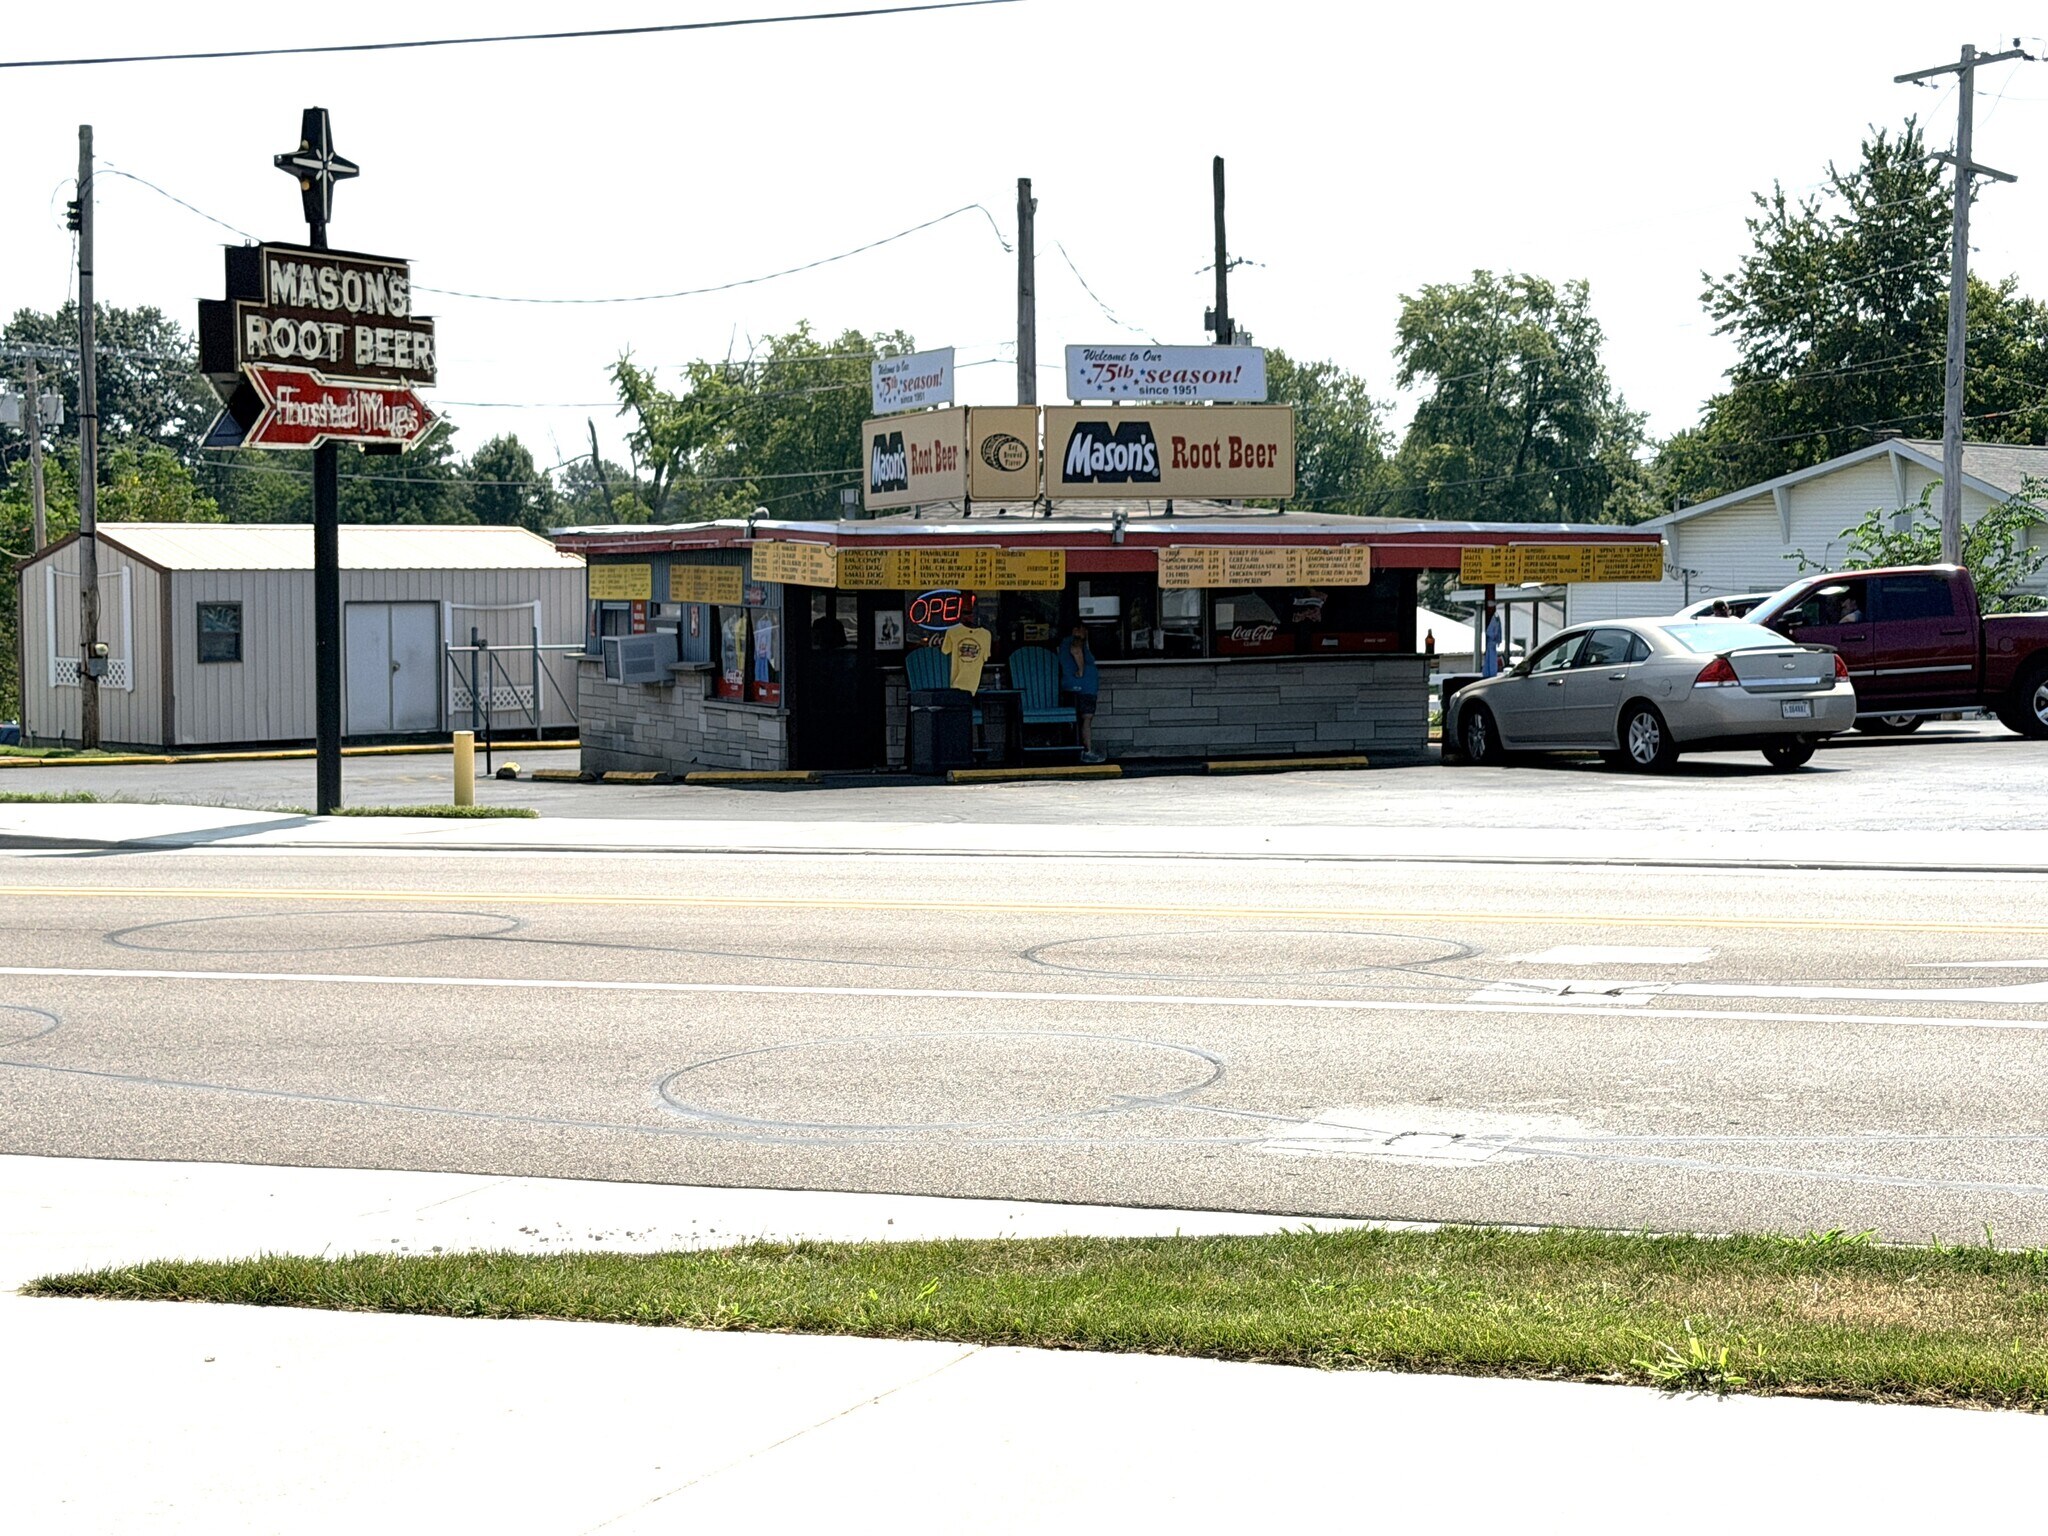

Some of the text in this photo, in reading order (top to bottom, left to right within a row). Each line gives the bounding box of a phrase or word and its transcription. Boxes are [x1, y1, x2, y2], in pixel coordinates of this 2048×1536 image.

[270, 260, 410, 318] MASON'S
[246, 315, 434, 371] ROOT BEER
[1083, 349, 1162, 362] Welcome to Our
[881, 367, 944, 396] 75th season!
[1092, 363, 1242, 384] 75th season!
[1139, 385, 1197, 395] since 1951
[277, 386, 419, 437] Frosted Mugs
[872, 439, 958, 487] Mason's Root Beer
[1066, 432, 1277, 477] Mason's Root Beer
